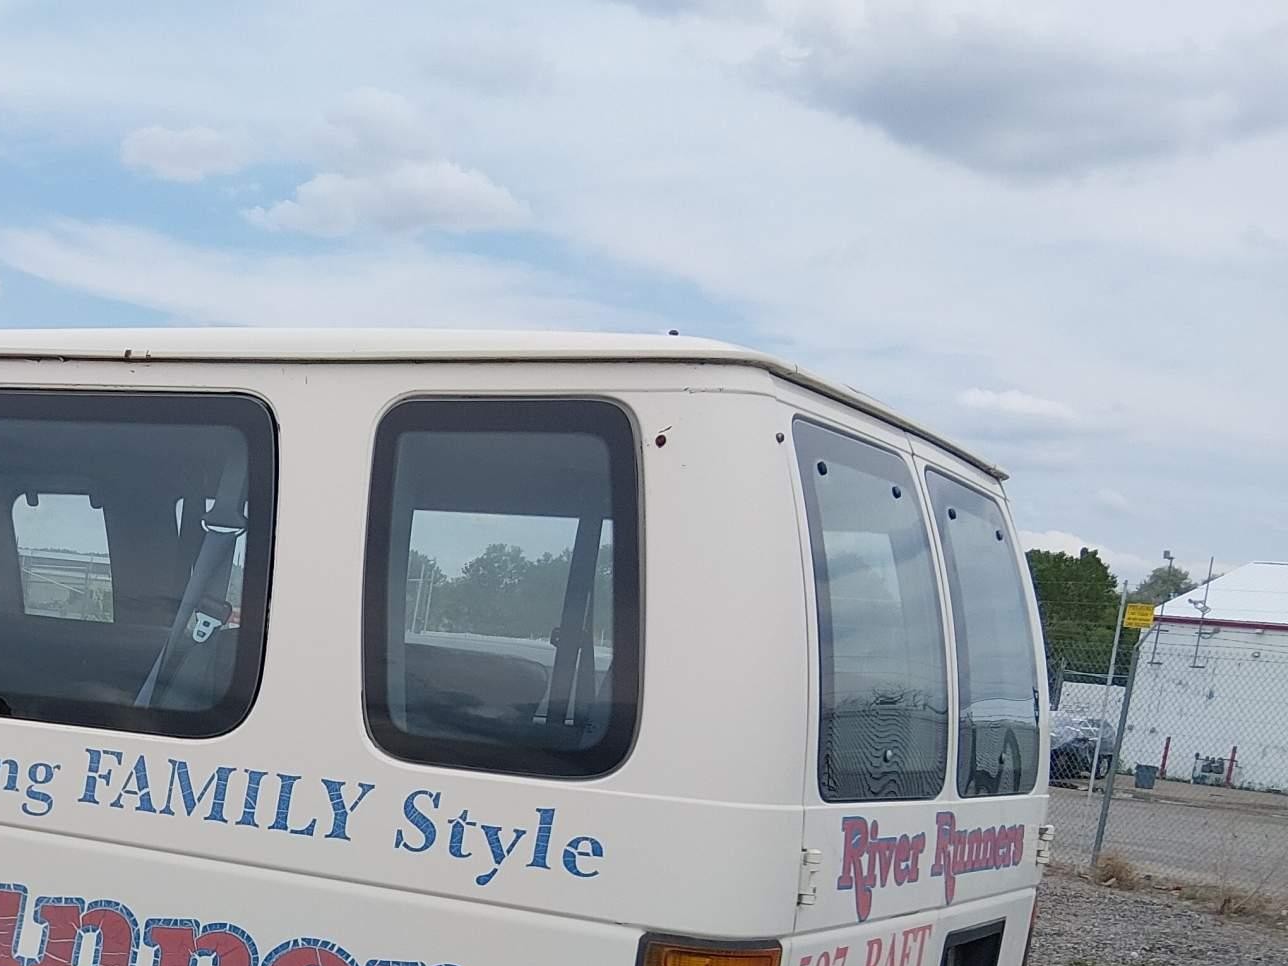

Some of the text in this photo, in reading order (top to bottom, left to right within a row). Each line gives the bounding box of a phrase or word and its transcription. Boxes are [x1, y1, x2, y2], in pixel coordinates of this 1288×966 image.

[77, 747, 375, 842] FAMILY
[394, 789, 605, 886] Style
[837, 810, 1026, 922] River Runners
